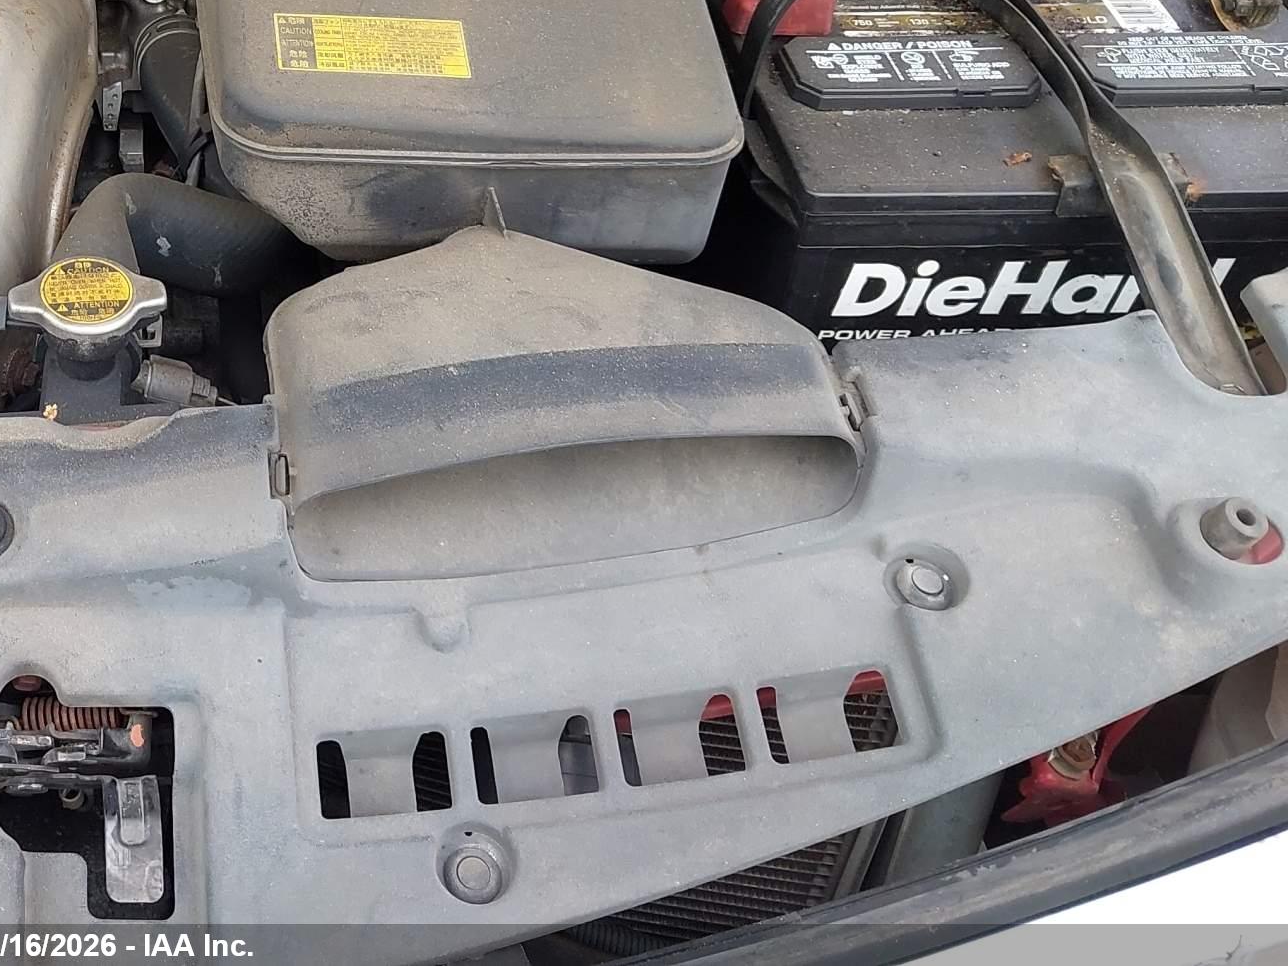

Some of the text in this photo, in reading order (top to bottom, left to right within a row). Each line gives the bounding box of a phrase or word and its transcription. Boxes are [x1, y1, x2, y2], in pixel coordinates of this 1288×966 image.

[280, 26, 312, 35] CAUTION
[841, 42, 903, 50] DANGER
[916, 41, 973, 49] POISON
[67, 265, 110, 275] CAUTION
[74, 300, 120, 309] ATTENTION
[818, 329, 912, 340] POWER
